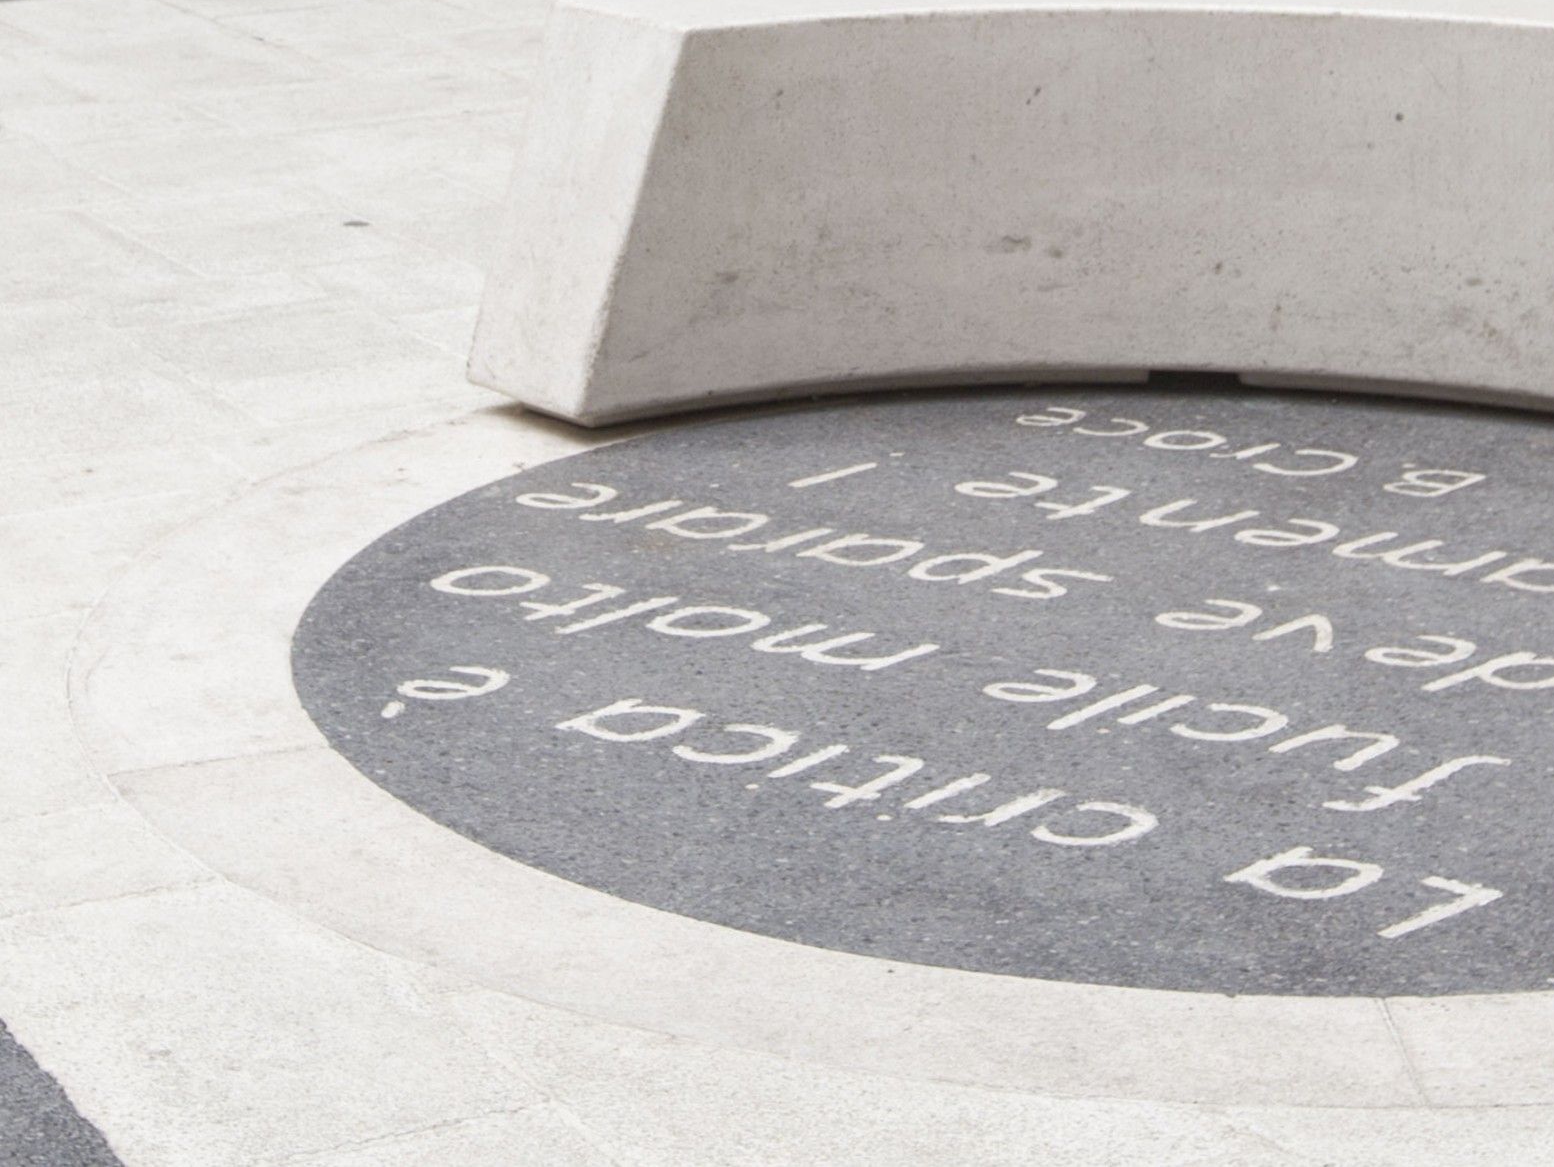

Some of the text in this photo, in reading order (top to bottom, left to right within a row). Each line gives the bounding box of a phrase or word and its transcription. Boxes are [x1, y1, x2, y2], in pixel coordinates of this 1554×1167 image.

[1016, 408, 1486, 497] B. Croce
[518, 484, 1113, 601] sparare
[430, 567, 941, 671] molto
[984, 668, 1512, 812] fucile
[382, 666, 1504, 940] La critica è
